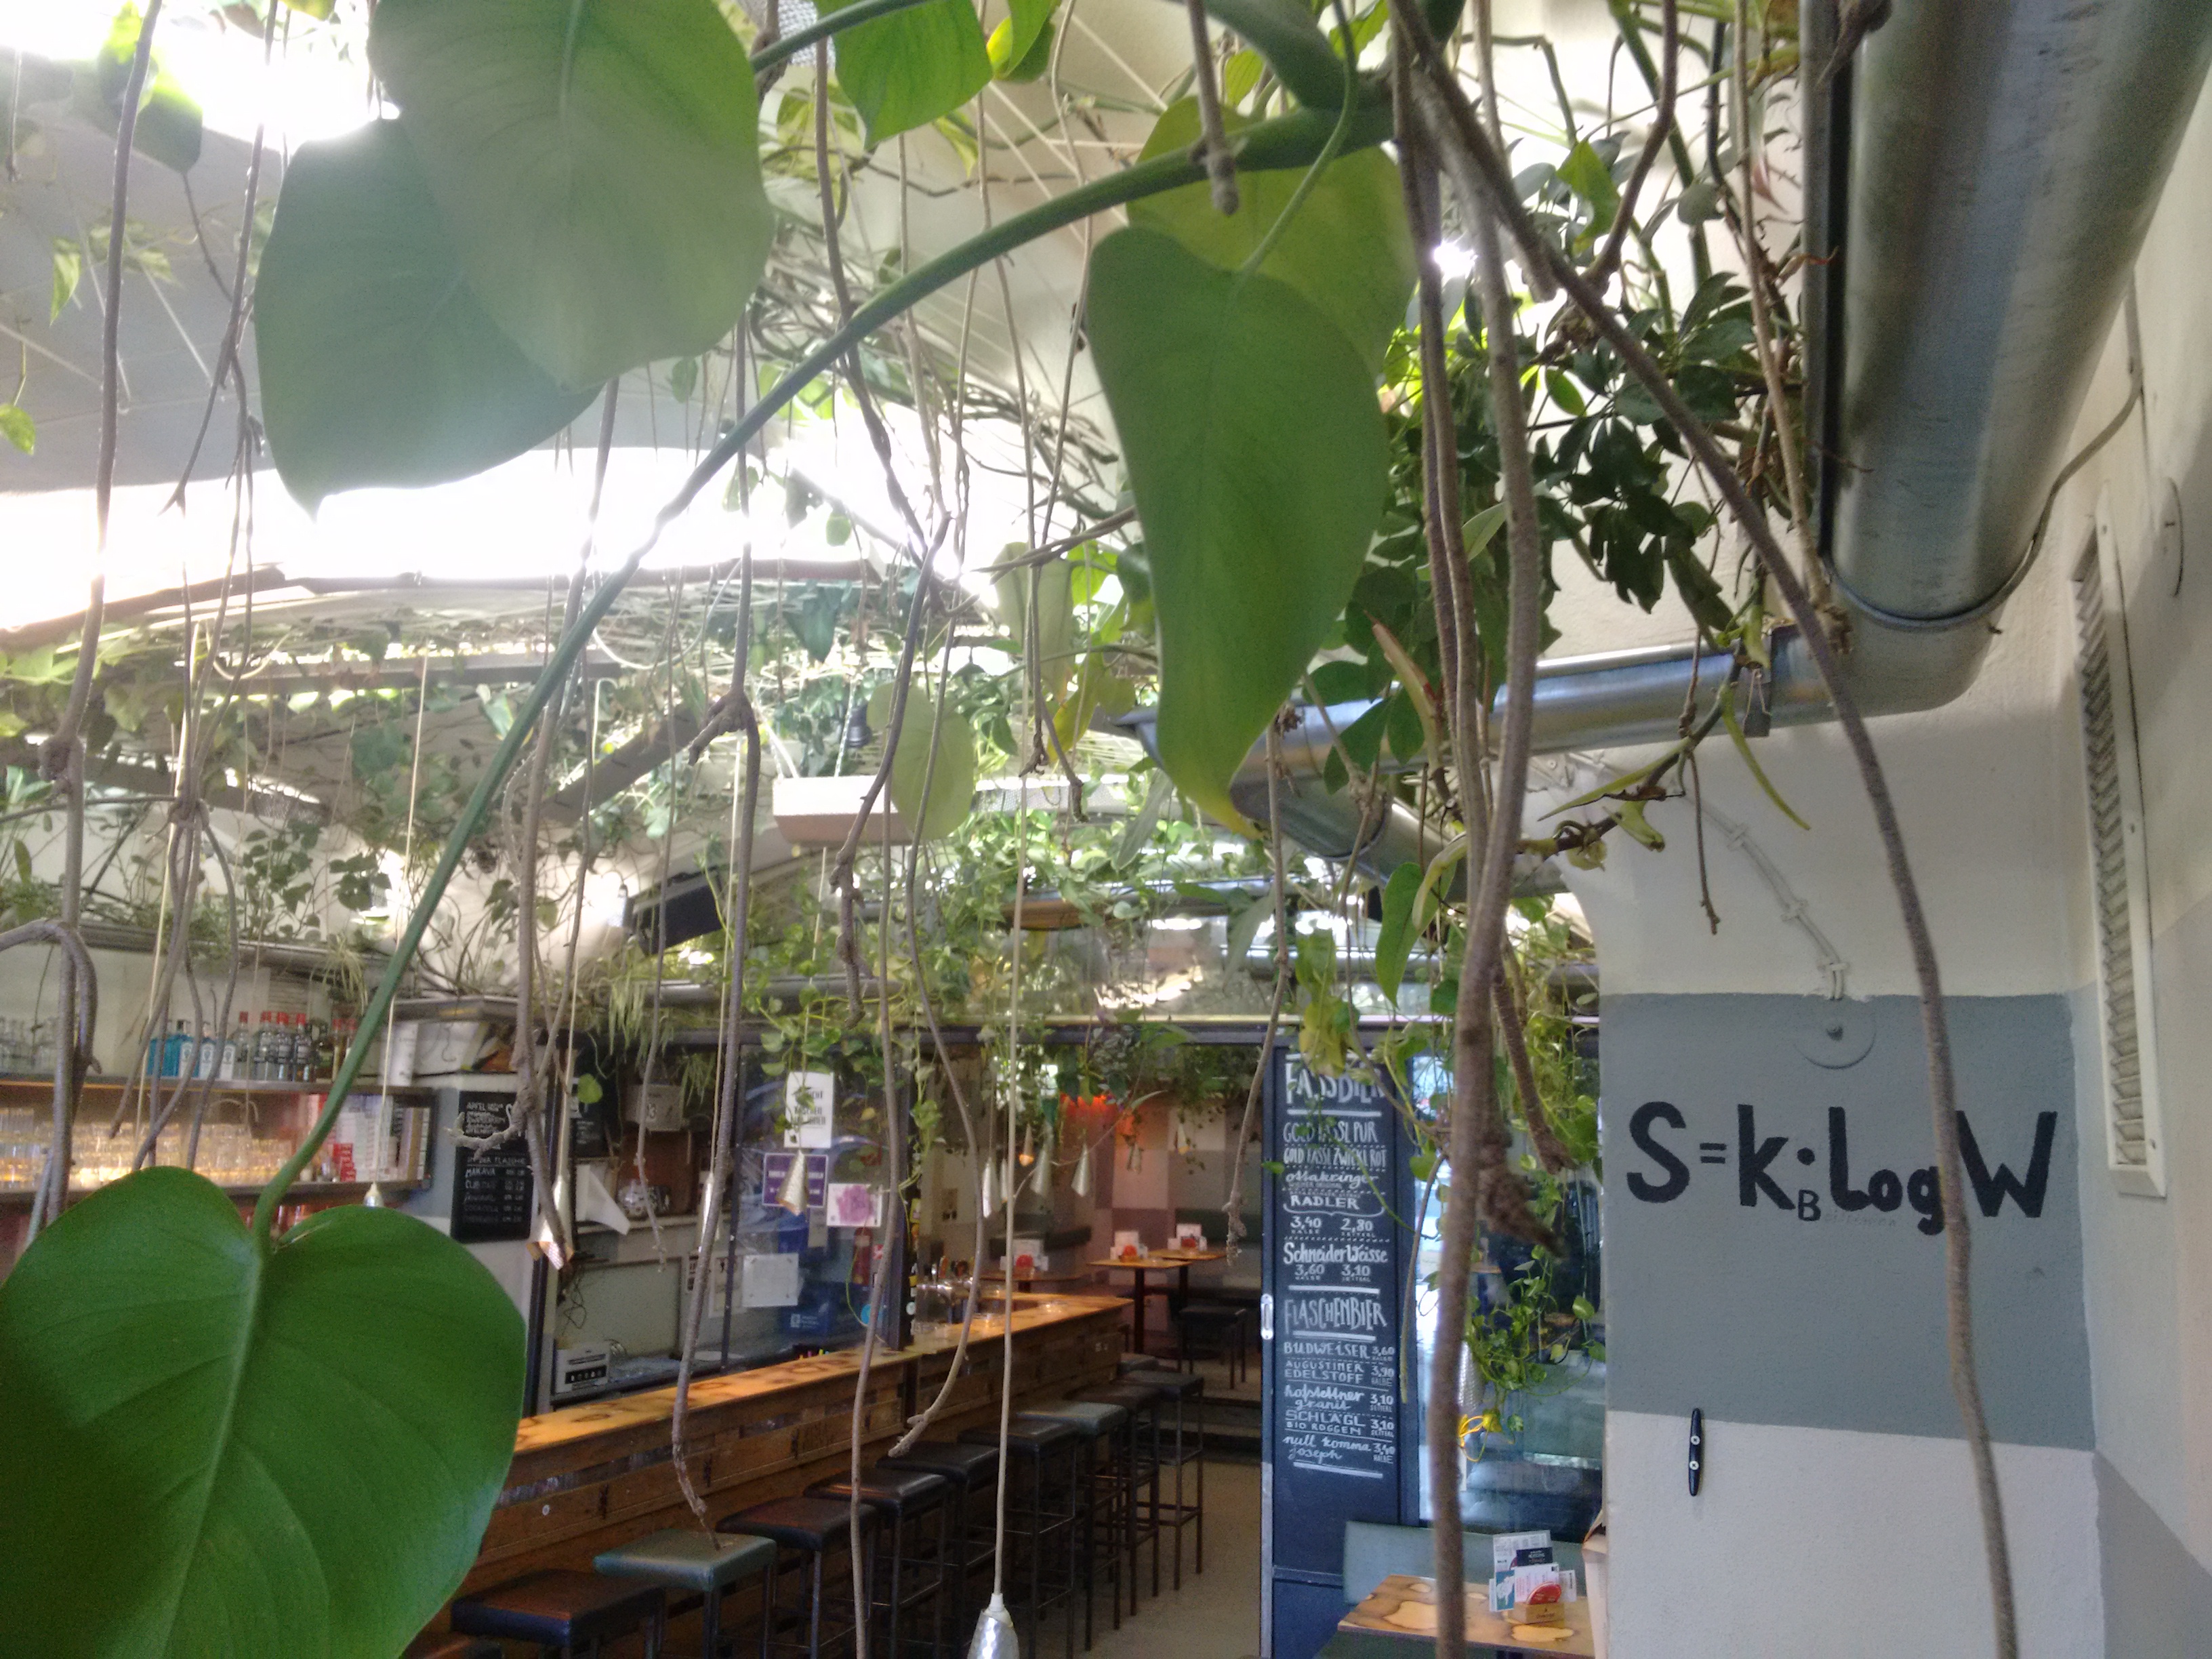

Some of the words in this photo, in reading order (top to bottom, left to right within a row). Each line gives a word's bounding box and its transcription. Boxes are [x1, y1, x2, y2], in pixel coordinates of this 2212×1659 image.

[1353, 1121, 1378, 1143] PUR
[1370, 1149, 1387, 1168] ROT
[1290, 1195, 1359, 1210] RADLER
[1290, 1216, 1322, 1229] 3,40
[1340, 1218, 1374, 1232] 2,80
[1283, 1242, 1347, 1265] Schneider
[1346, 1244, 1388, 1263] Weisse
[1294, 1264, 1326, 1277] 3,60
[1341, 1264, 1371, 1277] 3,10
[1284, 1296, 1388, 1335] FLASCHENBIER
[1372, 1346, 1395, 1357] 3,60
[1284, 1369, 1364, 1384] EDELSTOFF
[1286, 1360, 1364, 1373] AUGUSTINER
[1371, 1365, 1395, 1378] 3,90
[1295, 1399, 1351, 1411] granit
[1370, 1393, 1394, 1406] 3,10
[1286, 1421, 1307, 1429] BIO
[1311, 1423, 1361, 1435] ROGGEN
[1370, 1418, 1394, 1431] 3,10
[1282, 1434, 1316, 1447] null
[1322, 1436, 1371, 1451] komma
[1288, 1446, 1343, 1464] joseph
